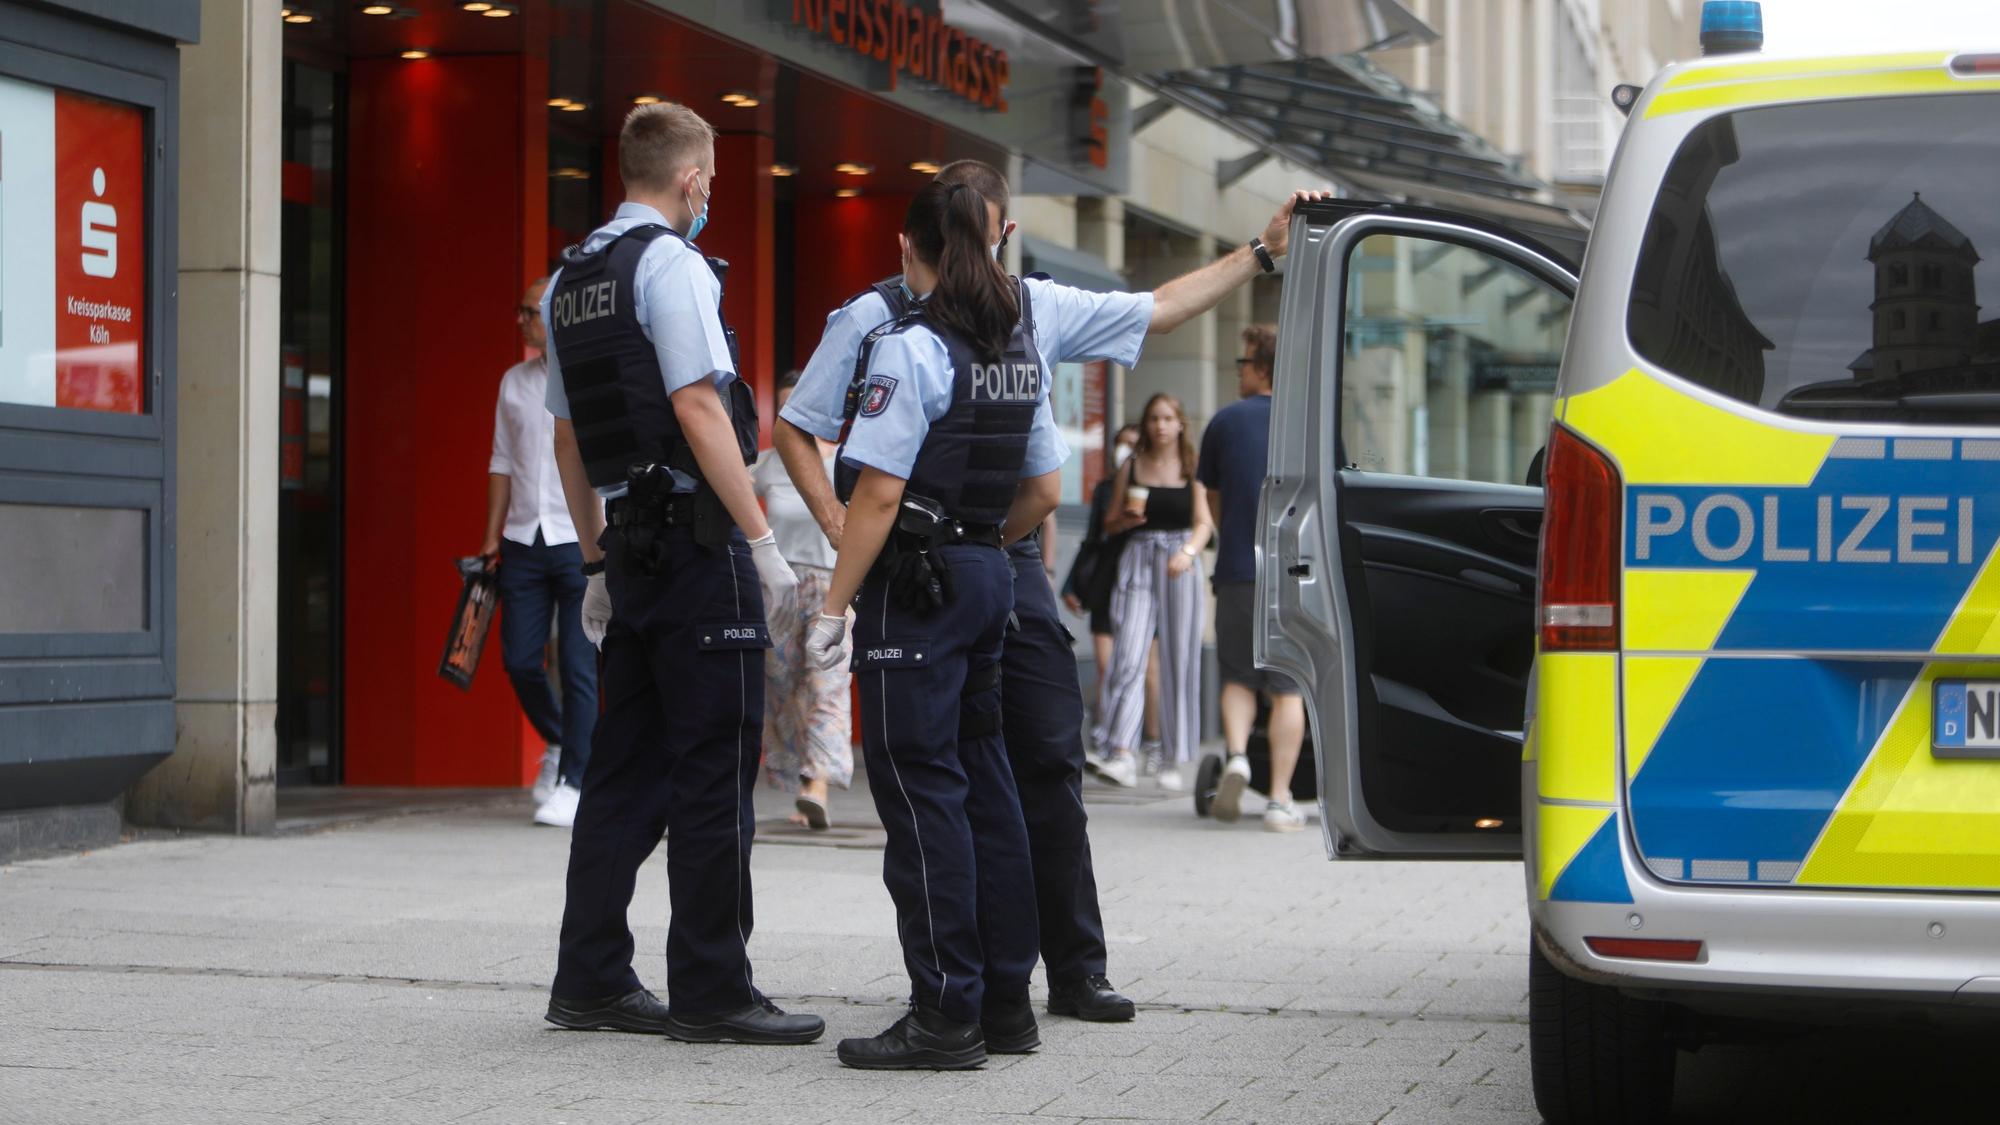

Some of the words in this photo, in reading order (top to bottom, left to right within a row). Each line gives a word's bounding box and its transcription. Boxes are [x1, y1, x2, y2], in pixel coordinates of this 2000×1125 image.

[792, 0, 1008, 113] eissparkasse
[67, 295, 131, 322] Kreissparkasse
[554, 280, 616, 331] POLIZEI
[90, 323, 110, 344] Köln
[970, 363, 1040, 400] POLIZEI
[1635, 494, 1974, 564] POLIZEI
[723, 628, 756, 639] POLIZEI
[867, 648, 903, 660] POLIZEI
[1945, 721, 1957, 736] D
[1967, 690, 2000, 739] N
